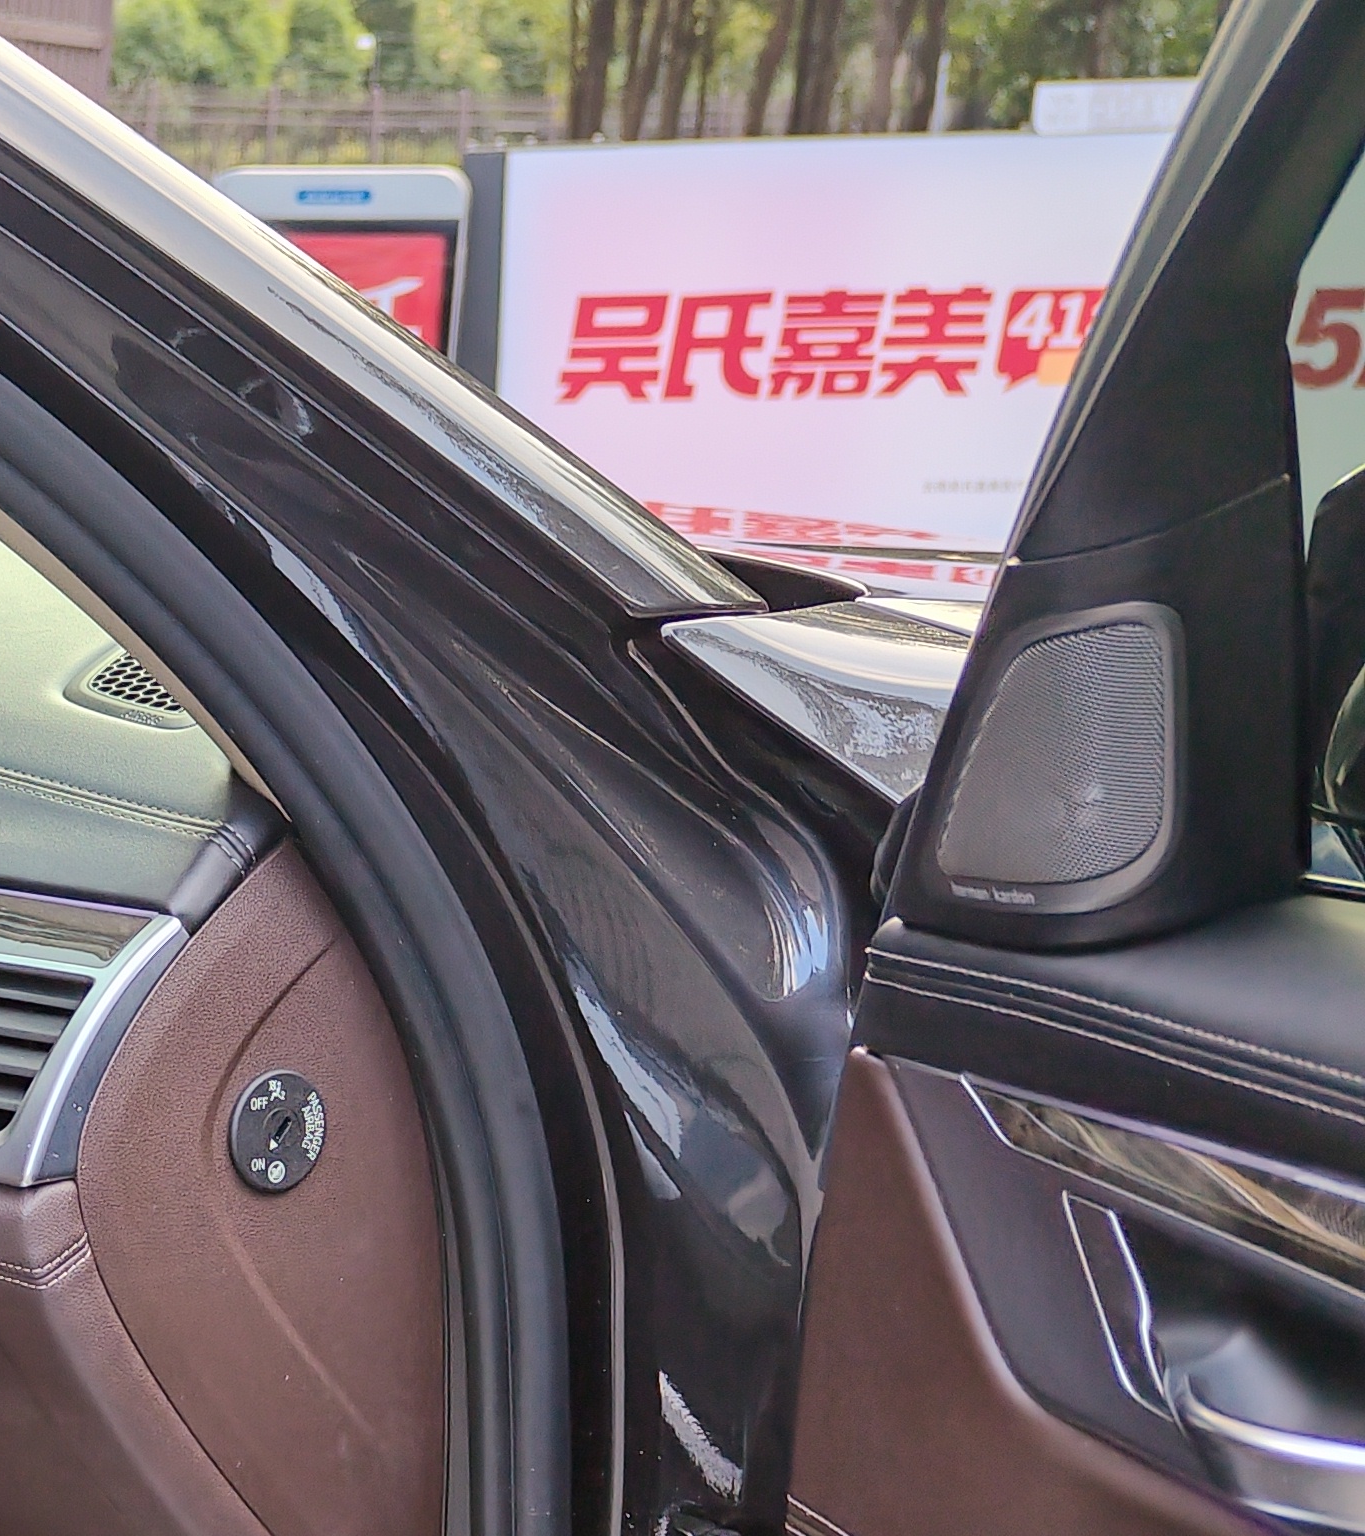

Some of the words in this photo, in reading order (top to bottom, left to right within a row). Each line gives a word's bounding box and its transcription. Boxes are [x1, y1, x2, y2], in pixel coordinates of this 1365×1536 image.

[559, 285, 993, 402] 吴氏嘉美
[250, 1096, 268, 1111] OFF
[301, 1107, 315, 1150] AIRBAG
[306, 1091, 325, 1161] PASSENGER
[250, 1158, 266, 1172] ON
